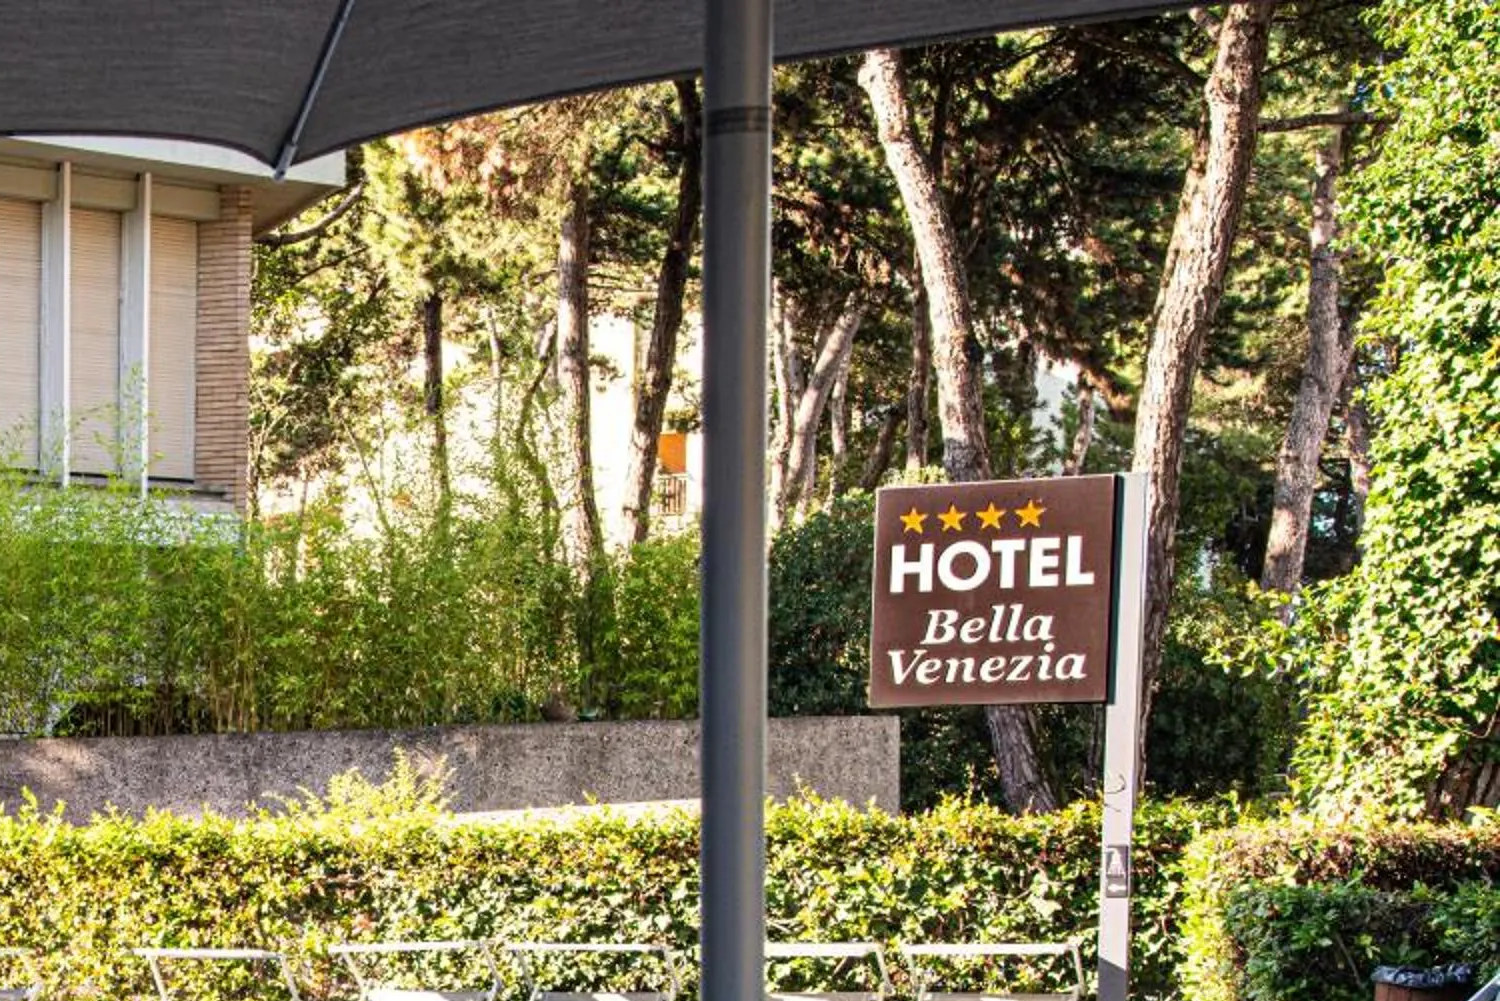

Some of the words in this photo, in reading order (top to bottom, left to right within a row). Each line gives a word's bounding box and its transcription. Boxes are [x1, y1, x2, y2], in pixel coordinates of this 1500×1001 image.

[890, 535, 1095, 593] HOTEL
[920, 604, 1054, 645] Bella
[888, 642, 1087, 685] Venezia
